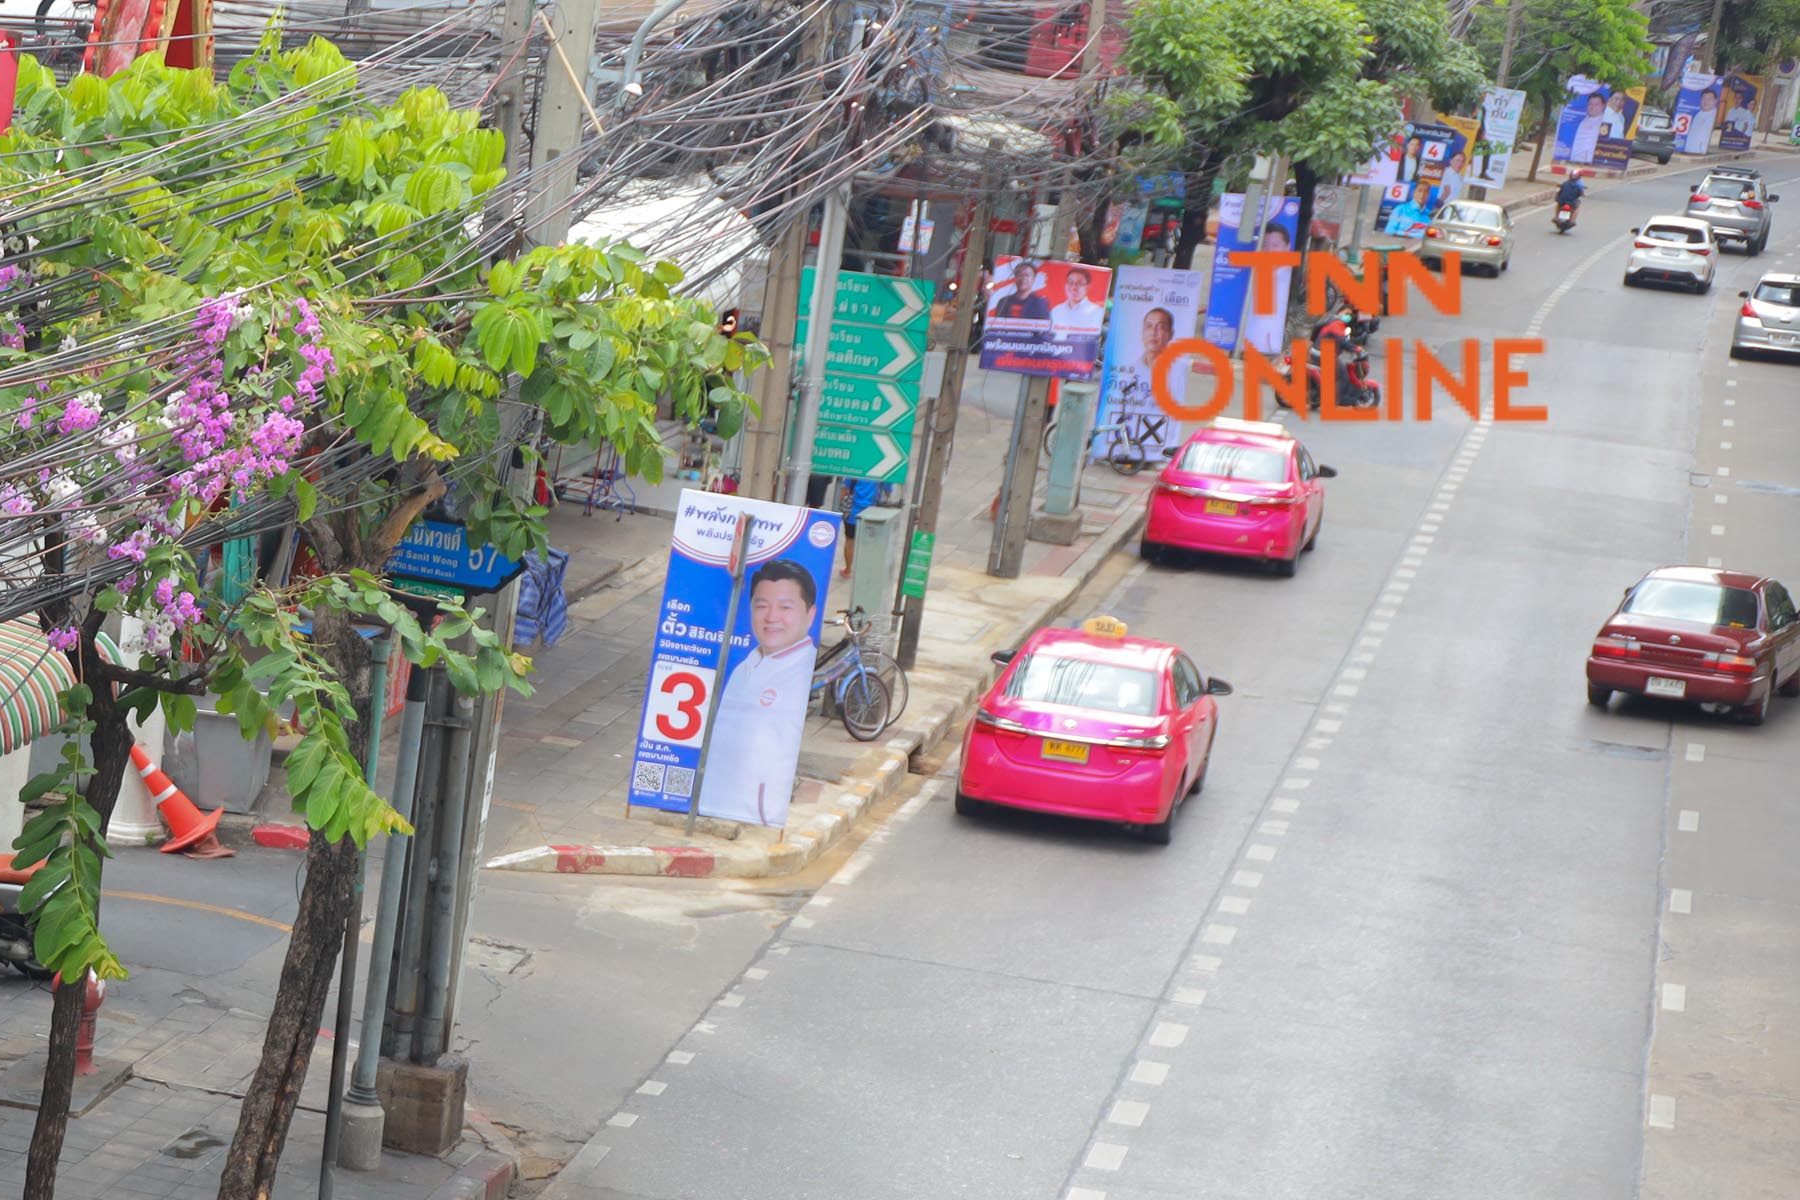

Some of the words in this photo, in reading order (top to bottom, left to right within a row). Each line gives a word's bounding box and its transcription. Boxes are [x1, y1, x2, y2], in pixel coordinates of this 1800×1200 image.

[1675, 116, 1689, 133] 3
[1428, 144, 1438, 158] 4
[406, 549, 430, 563] Sanit
[432, 554, 458, 568] Wong
[667, 599, 691, 612] เลือก
[656, 672, 706, 740] 3
